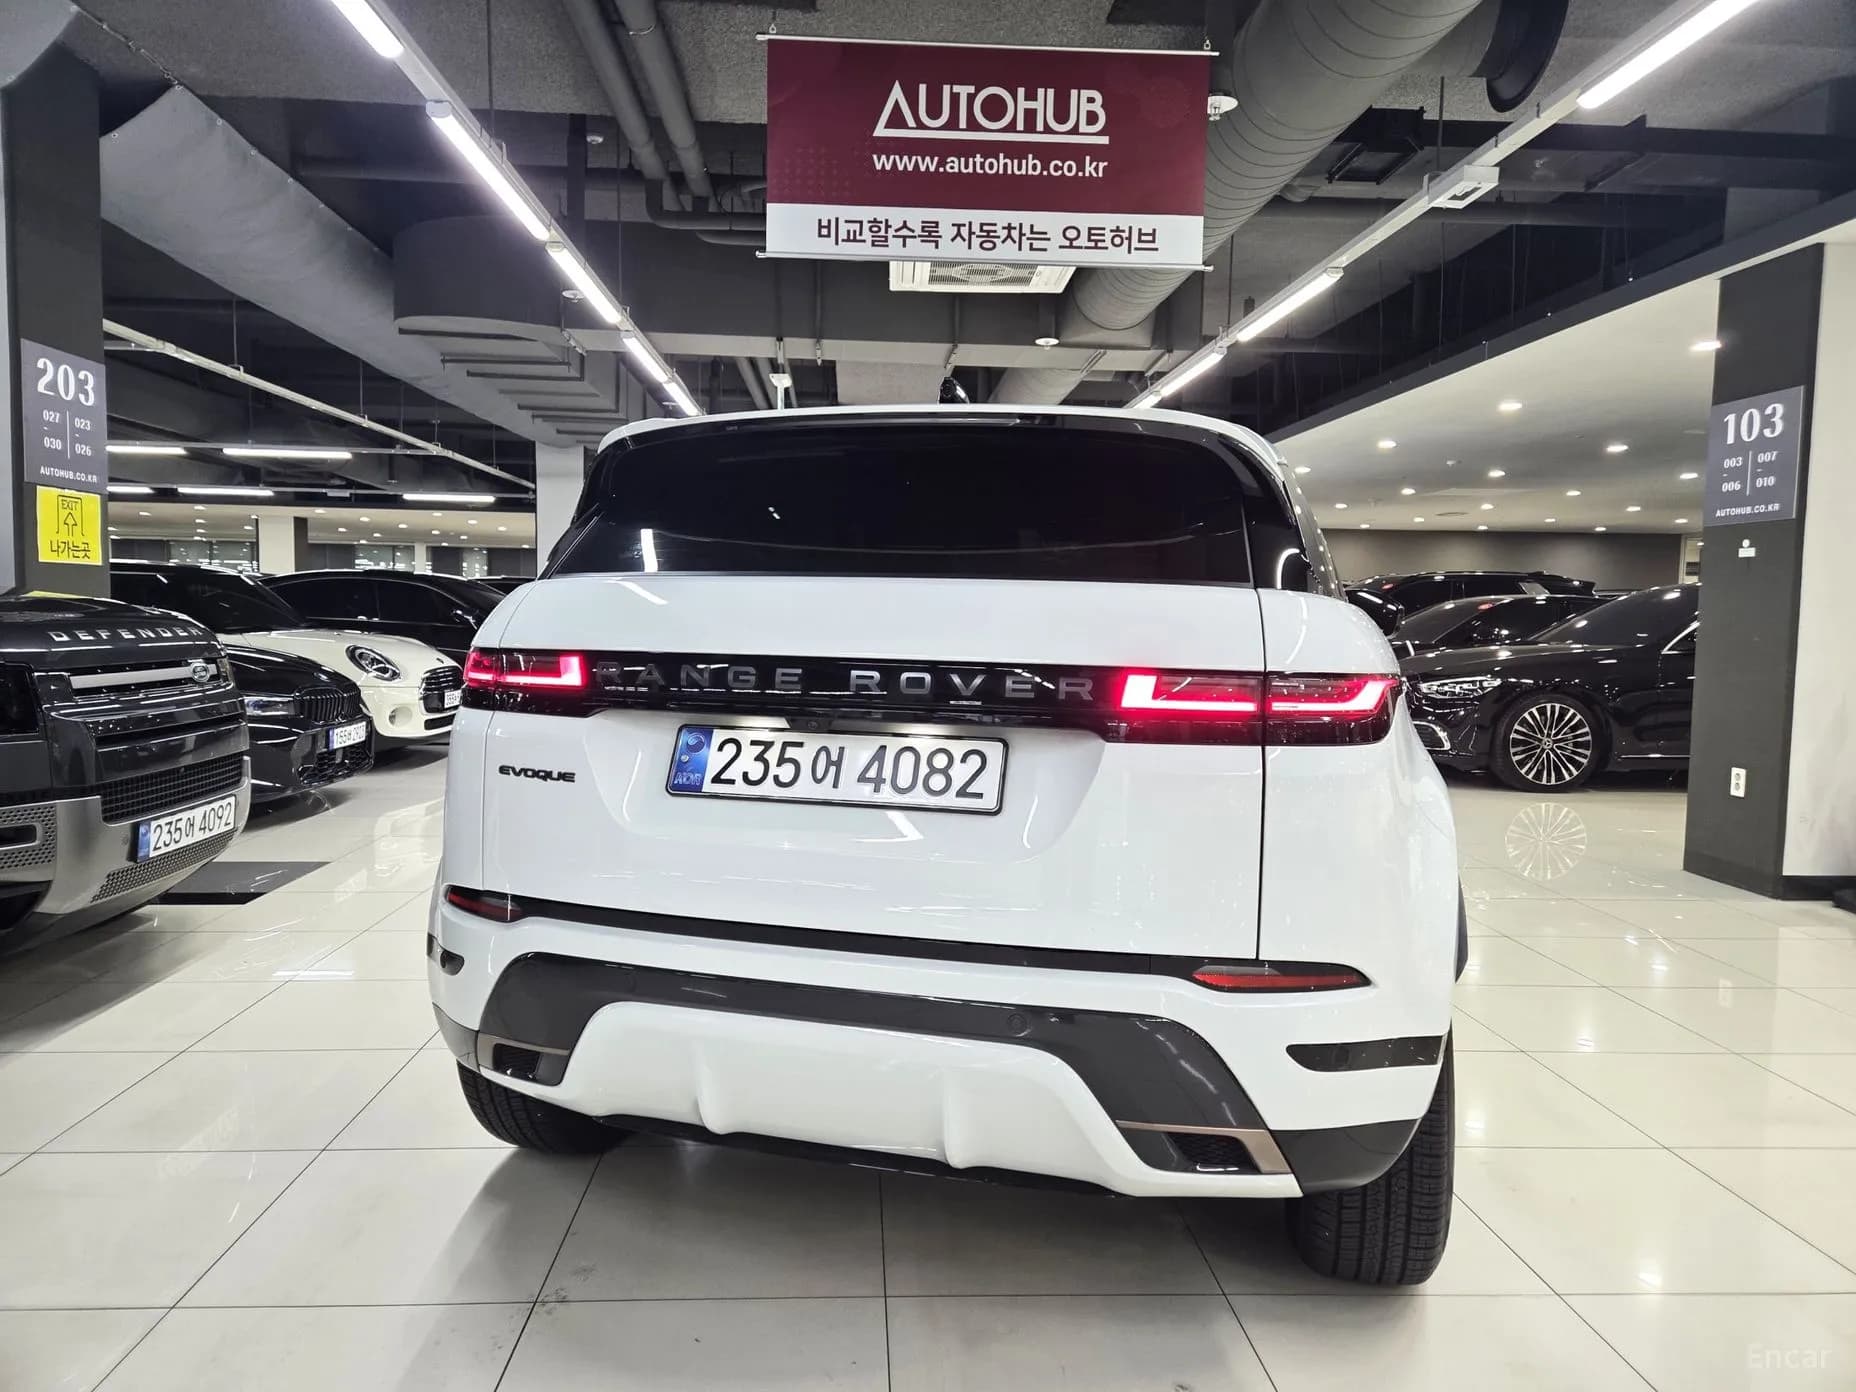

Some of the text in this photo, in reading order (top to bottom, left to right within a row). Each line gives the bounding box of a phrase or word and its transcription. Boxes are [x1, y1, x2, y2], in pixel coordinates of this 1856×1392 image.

[873, 80, 1108, 141] AUTOHUB
[872, 152, 1109, 178] www.autohub.co.kr
[816, 216, 1160, 255] 비교할수록 자동차는 오토허브
[36, 357, 95, 407] 203
[42, 409, 60, 424] 027
[74, 416, 91, 431] 023
[1723, 402, 1785, 445] 103
[43, 436, 62, 450] 030
[75, 443, 92, 457] 026
[1723, 456, 1743, 469] 003
[1757, 451, 1778, 464] 007
[40, 465, 97, 483] AUTOHUB.CO.KR
[1755, 476, 1776, 488] 010
[1721, 481, 1741, 493] 006
[61, 499, 79, 511] EXIT
[1715, 502, 1780, 518] AUTOHUB.CO.KR
[49, 539, 91, 559] 나가는곳
[48, 626, 204, 642] DEFENDER
[596, 661, 1094, 701] RANGE ROVER
[498, 764, 576, 783] EVOQUE
[711, 738, 986, 801] 235어 4082
[152, 801, 232, 852] 235어 4092
